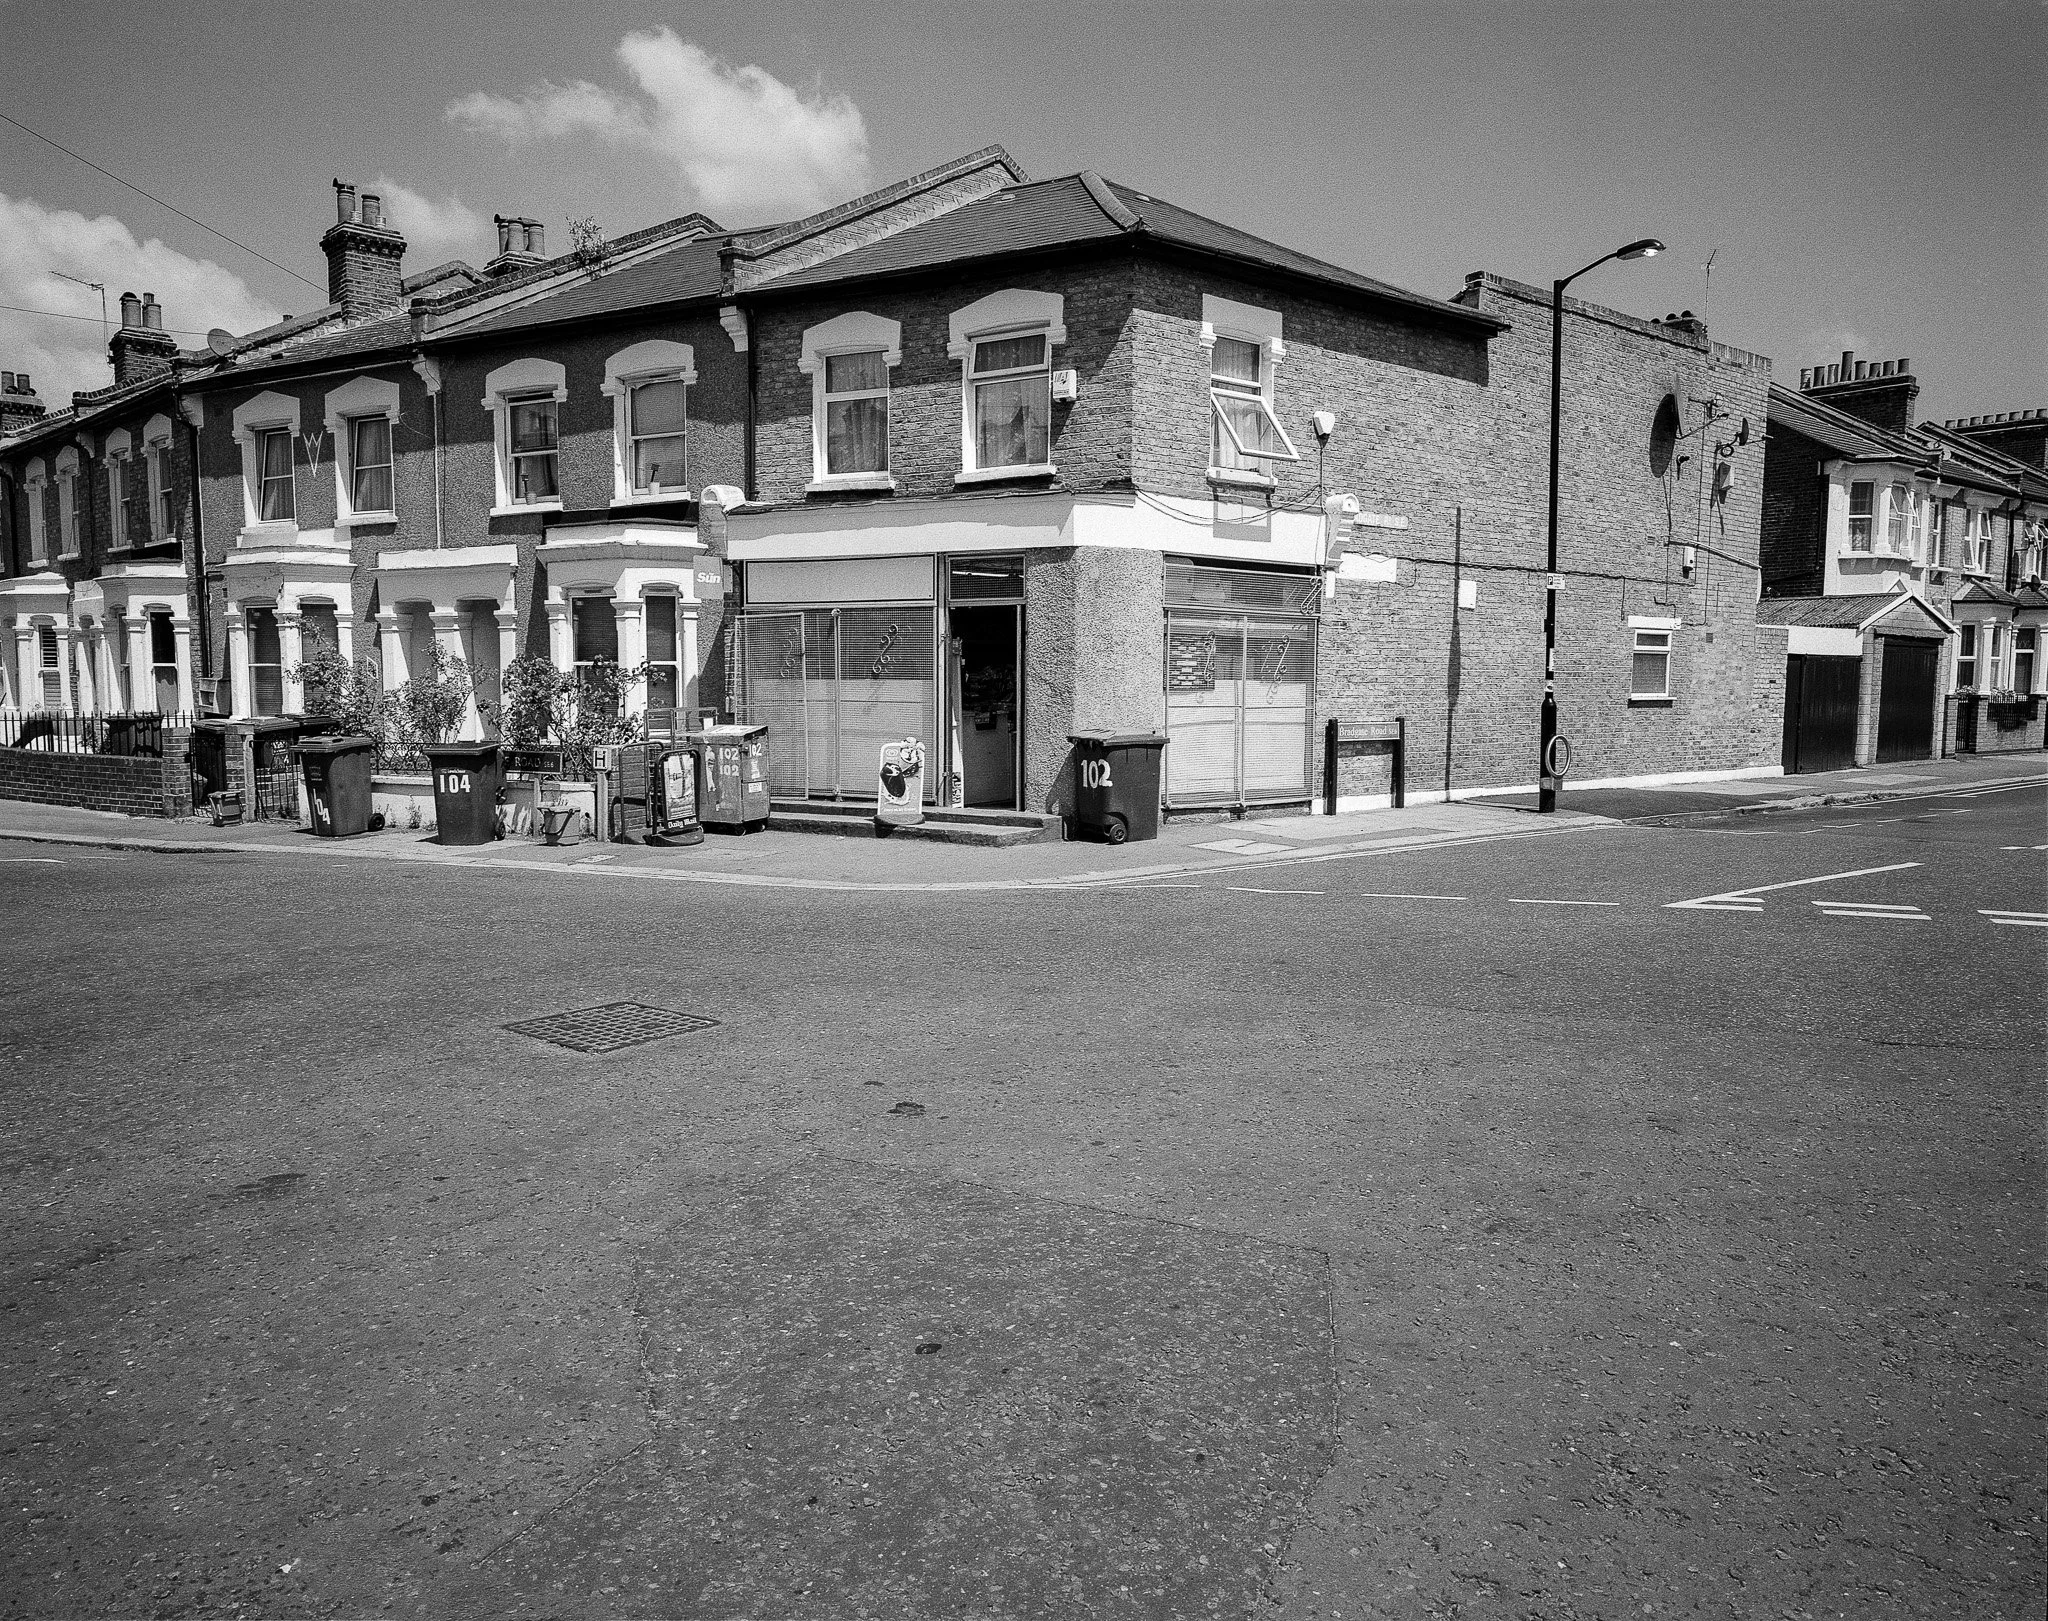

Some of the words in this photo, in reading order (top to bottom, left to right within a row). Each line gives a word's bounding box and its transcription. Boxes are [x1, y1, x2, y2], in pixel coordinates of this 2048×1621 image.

[697, 572, 721, 584] Sun
[1340, 726, 1369, 738] Bradgate
[1370, 725, 1387, 735] Road
[594, 750, 605, 767] H
[719, 747, 739, 760] 102
[514, 756, 541, 768] ROAD
[719, 764, 739, 777] 102
[1081, 758, 1113, 789] 102
[439, 774, 471, 793] 104
[313, 788, 331, 825] 104
